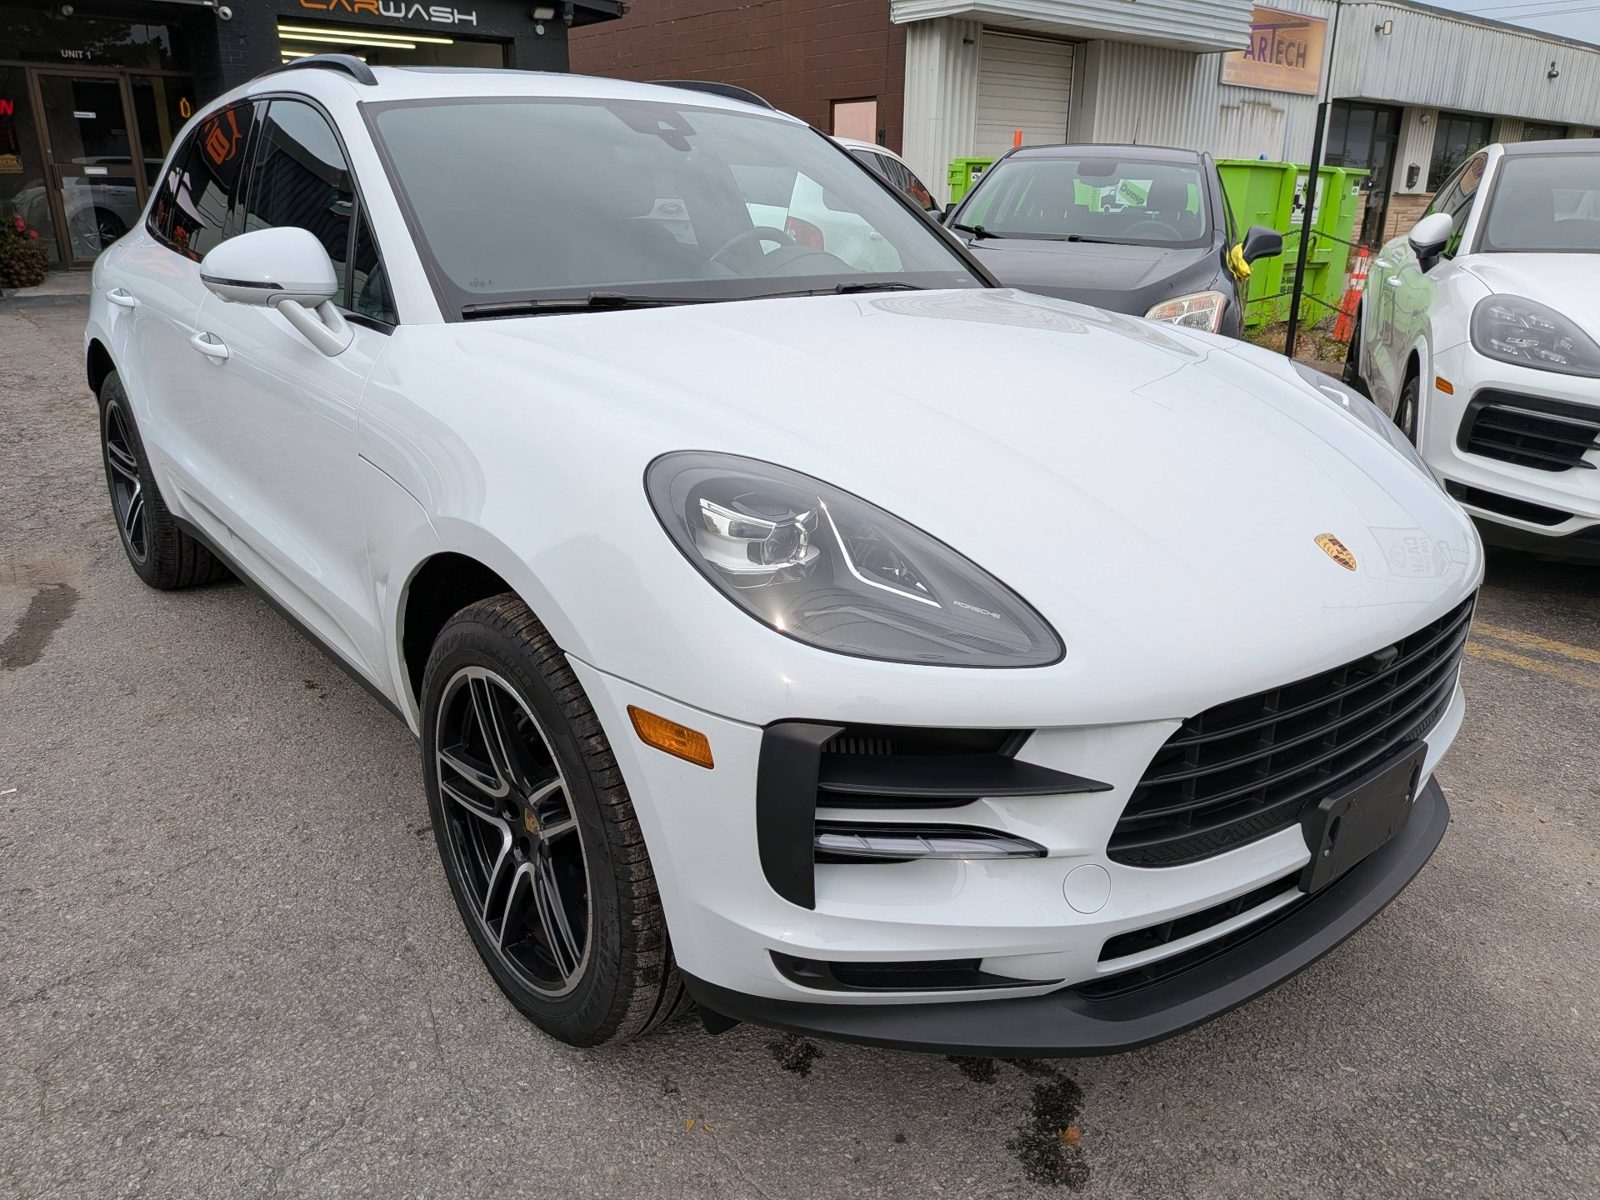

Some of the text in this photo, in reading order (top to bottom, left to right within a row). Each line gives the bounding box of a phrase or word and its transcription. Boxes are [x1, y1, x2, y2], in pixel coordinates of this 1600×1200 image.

[60, 49, 92, 60] UNIT 1
[953, 600, 1001, 620] PORSCHE
